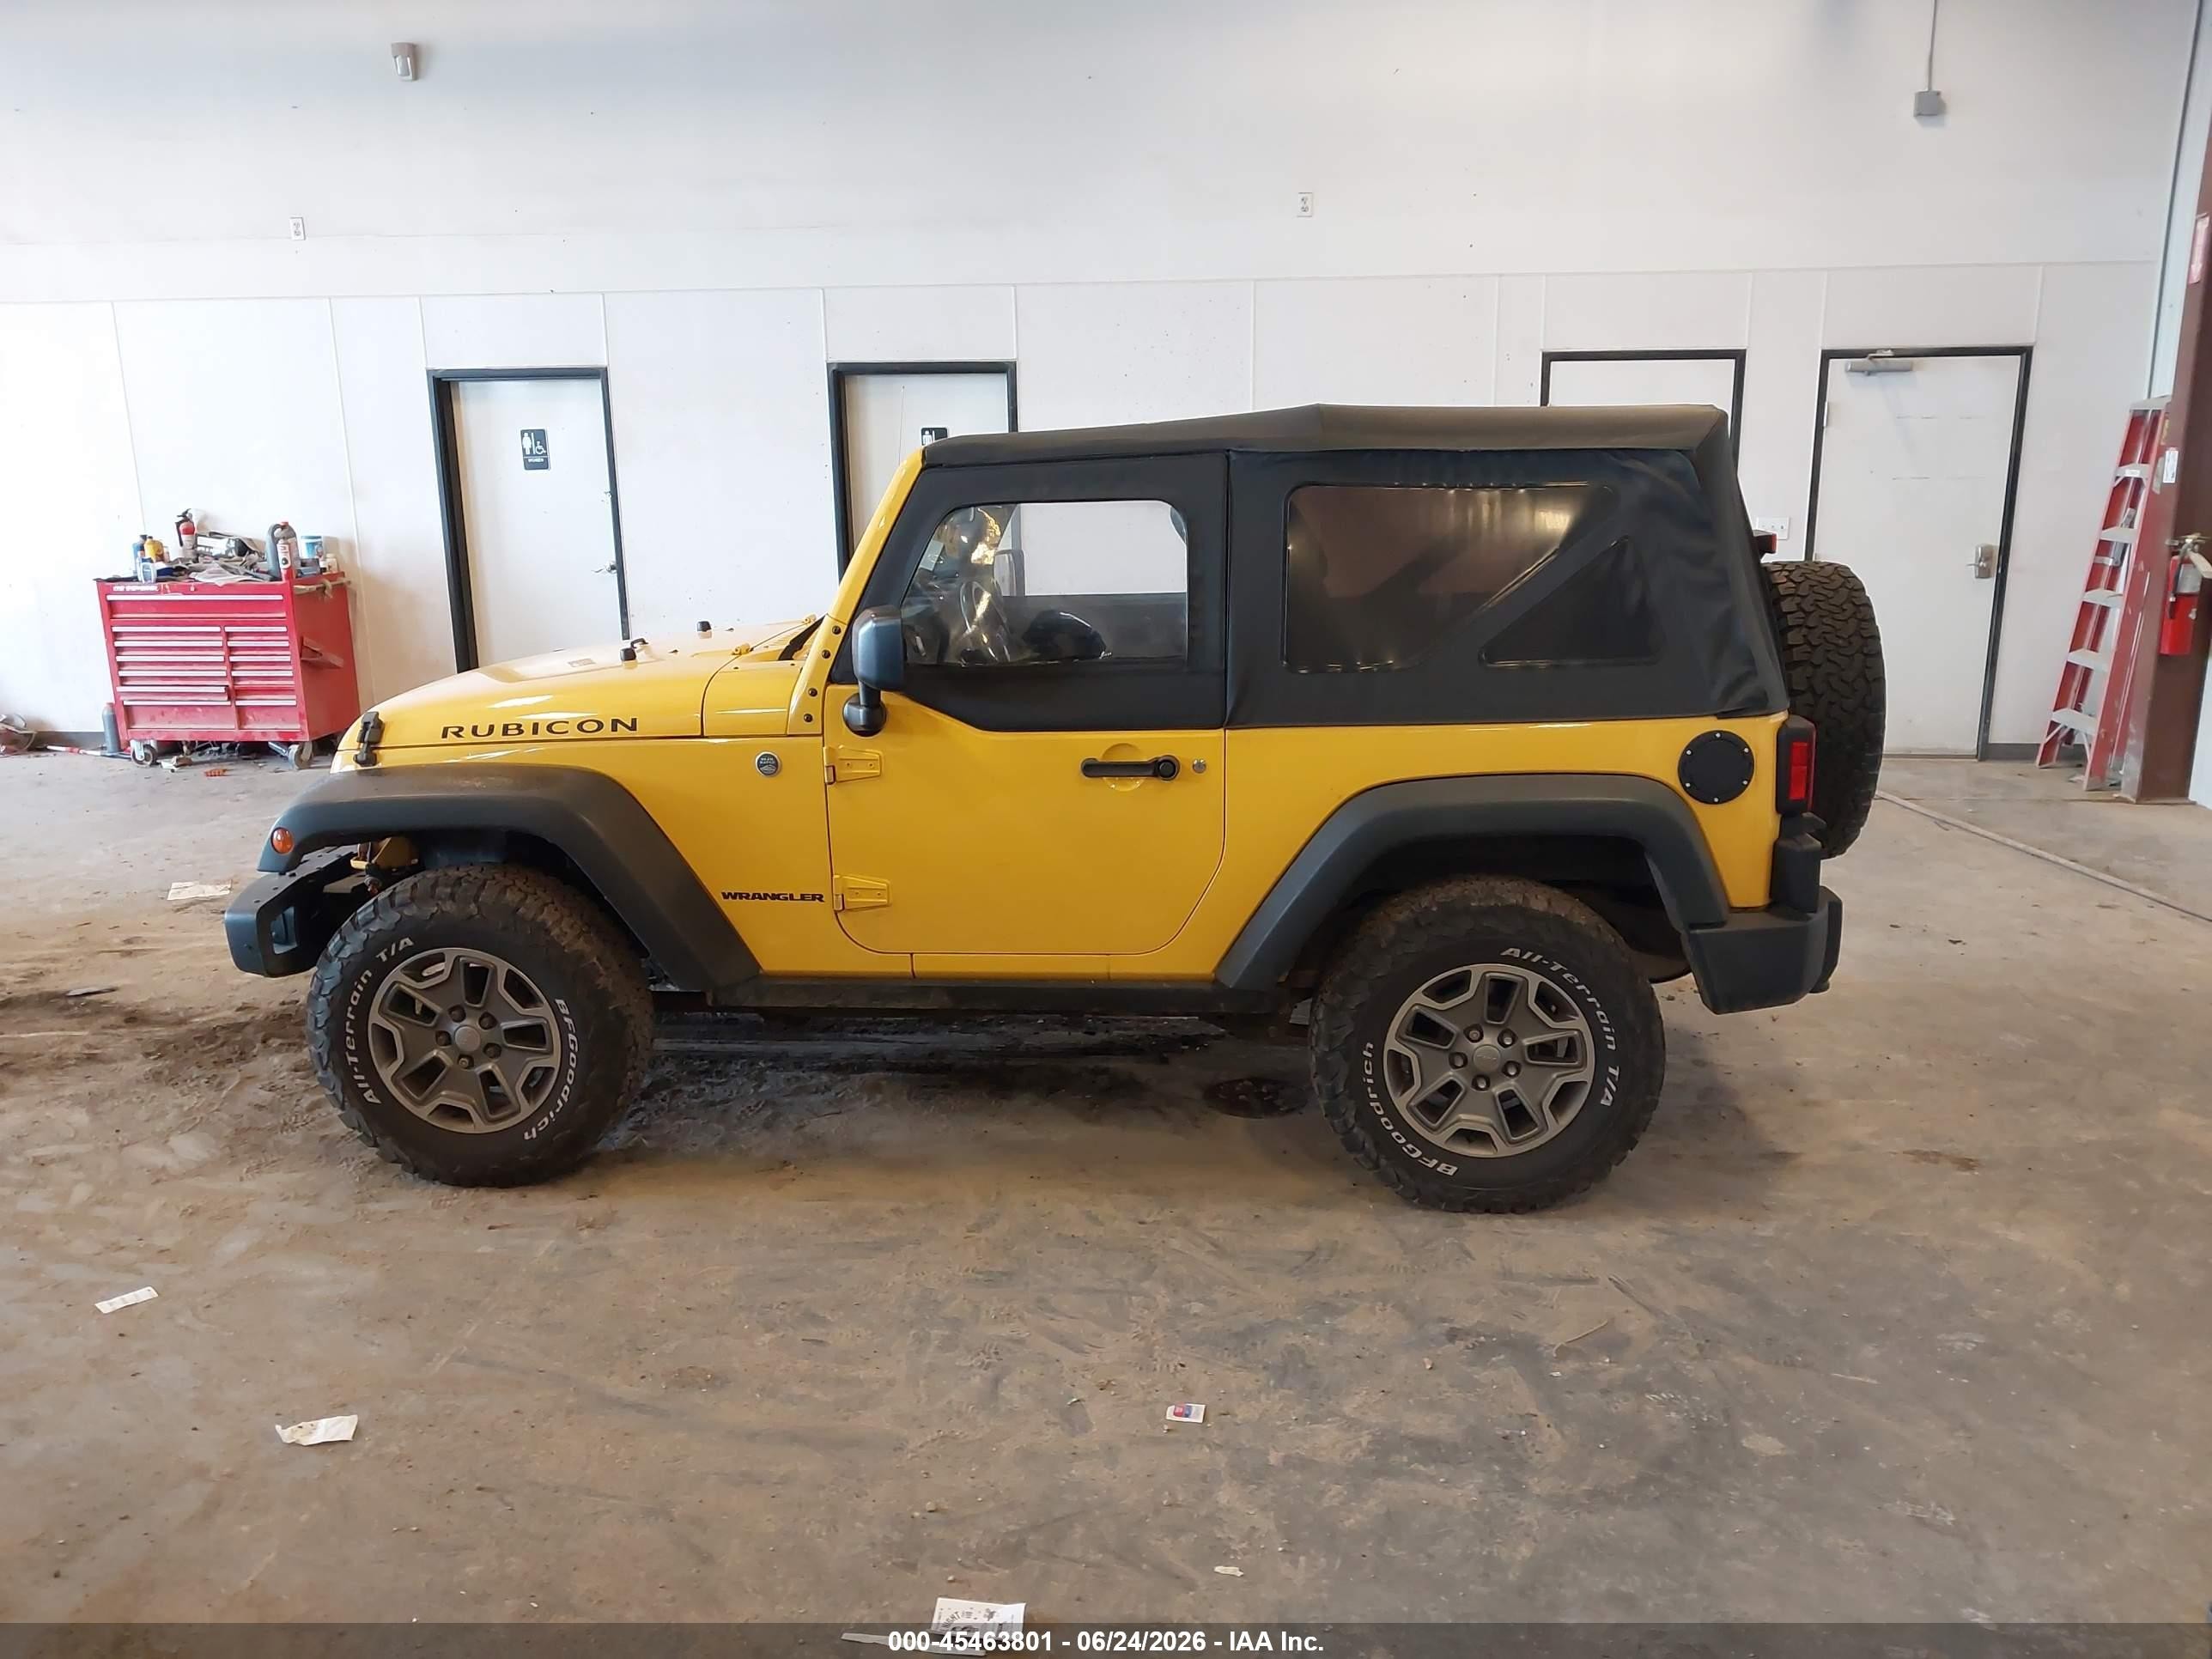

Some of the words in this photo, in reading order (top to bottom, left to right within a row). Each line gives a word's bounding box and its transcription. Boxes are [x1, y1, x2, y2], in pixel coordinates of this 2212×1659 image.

[441, 716, 638, 739] RUBICON
[720, 890, 825, 903] WRANGLER
[344, 969, 381, 1105] All-Terrain
[375, 936, 415, 963] T/A
[524, 998, 579, 1141] BFGoodrich
[1499, 946, 1620, 1052] All-Terrain
[1600, 1065, 1620, 1107] T/A
[1361, 1042, 1460, 1177] BFGoodrich
